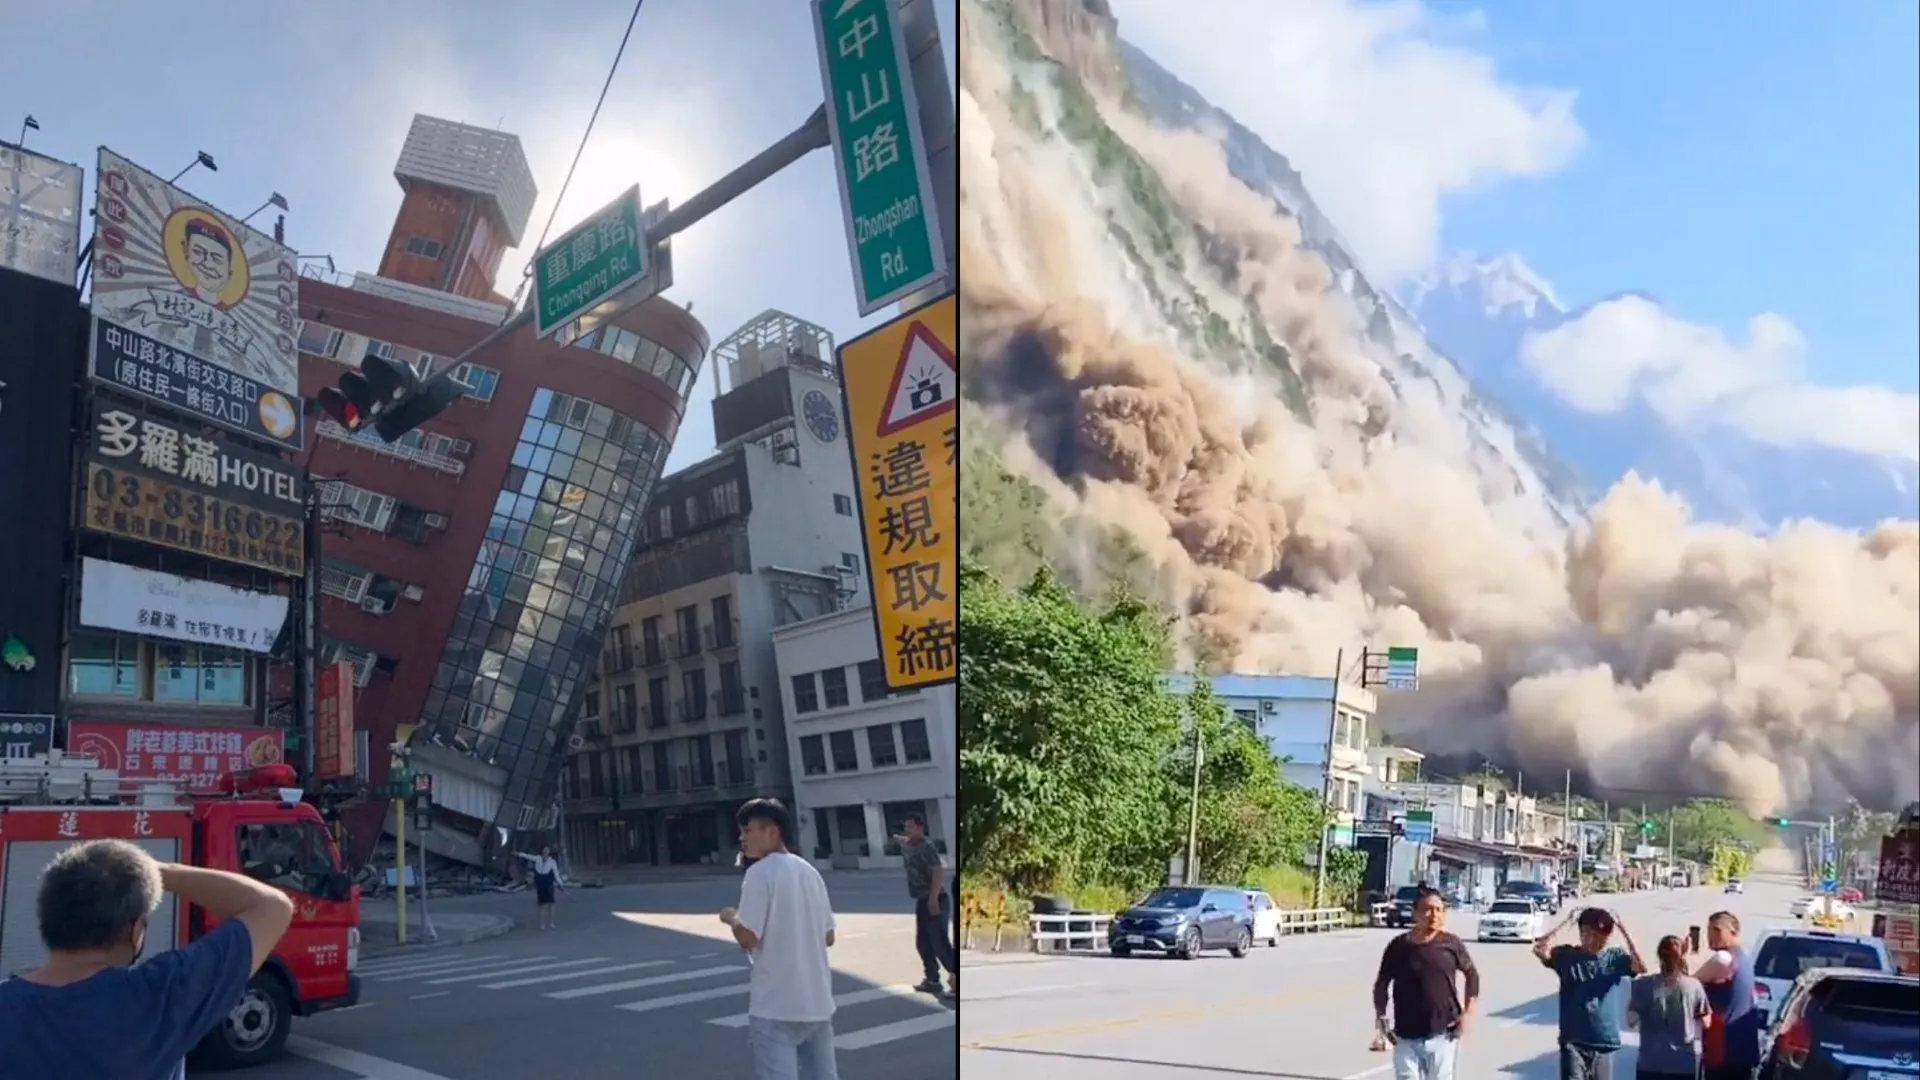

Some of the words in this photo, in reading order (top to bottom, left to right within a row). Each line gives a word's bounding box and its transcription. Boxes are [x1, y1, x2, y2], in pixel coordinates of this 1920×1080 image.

[839, 13, 900, 184] 中山路
[547, 213, 630, 287] 重慶路
[855, 194, 920, 245] Zhongshan
[548, 270, 608, 317] Chongqing
[880, 247, 909, 282] Rd.
[105, 327, 257, 403] 中山路北濱街交叉路口
[96, 410, 220, 488] 多羅滿
[220, 454, 303, 505] HOTEL
[94, 468, 301, 550] 03-8316622
[871, 441, 955, 677] 違規取締
